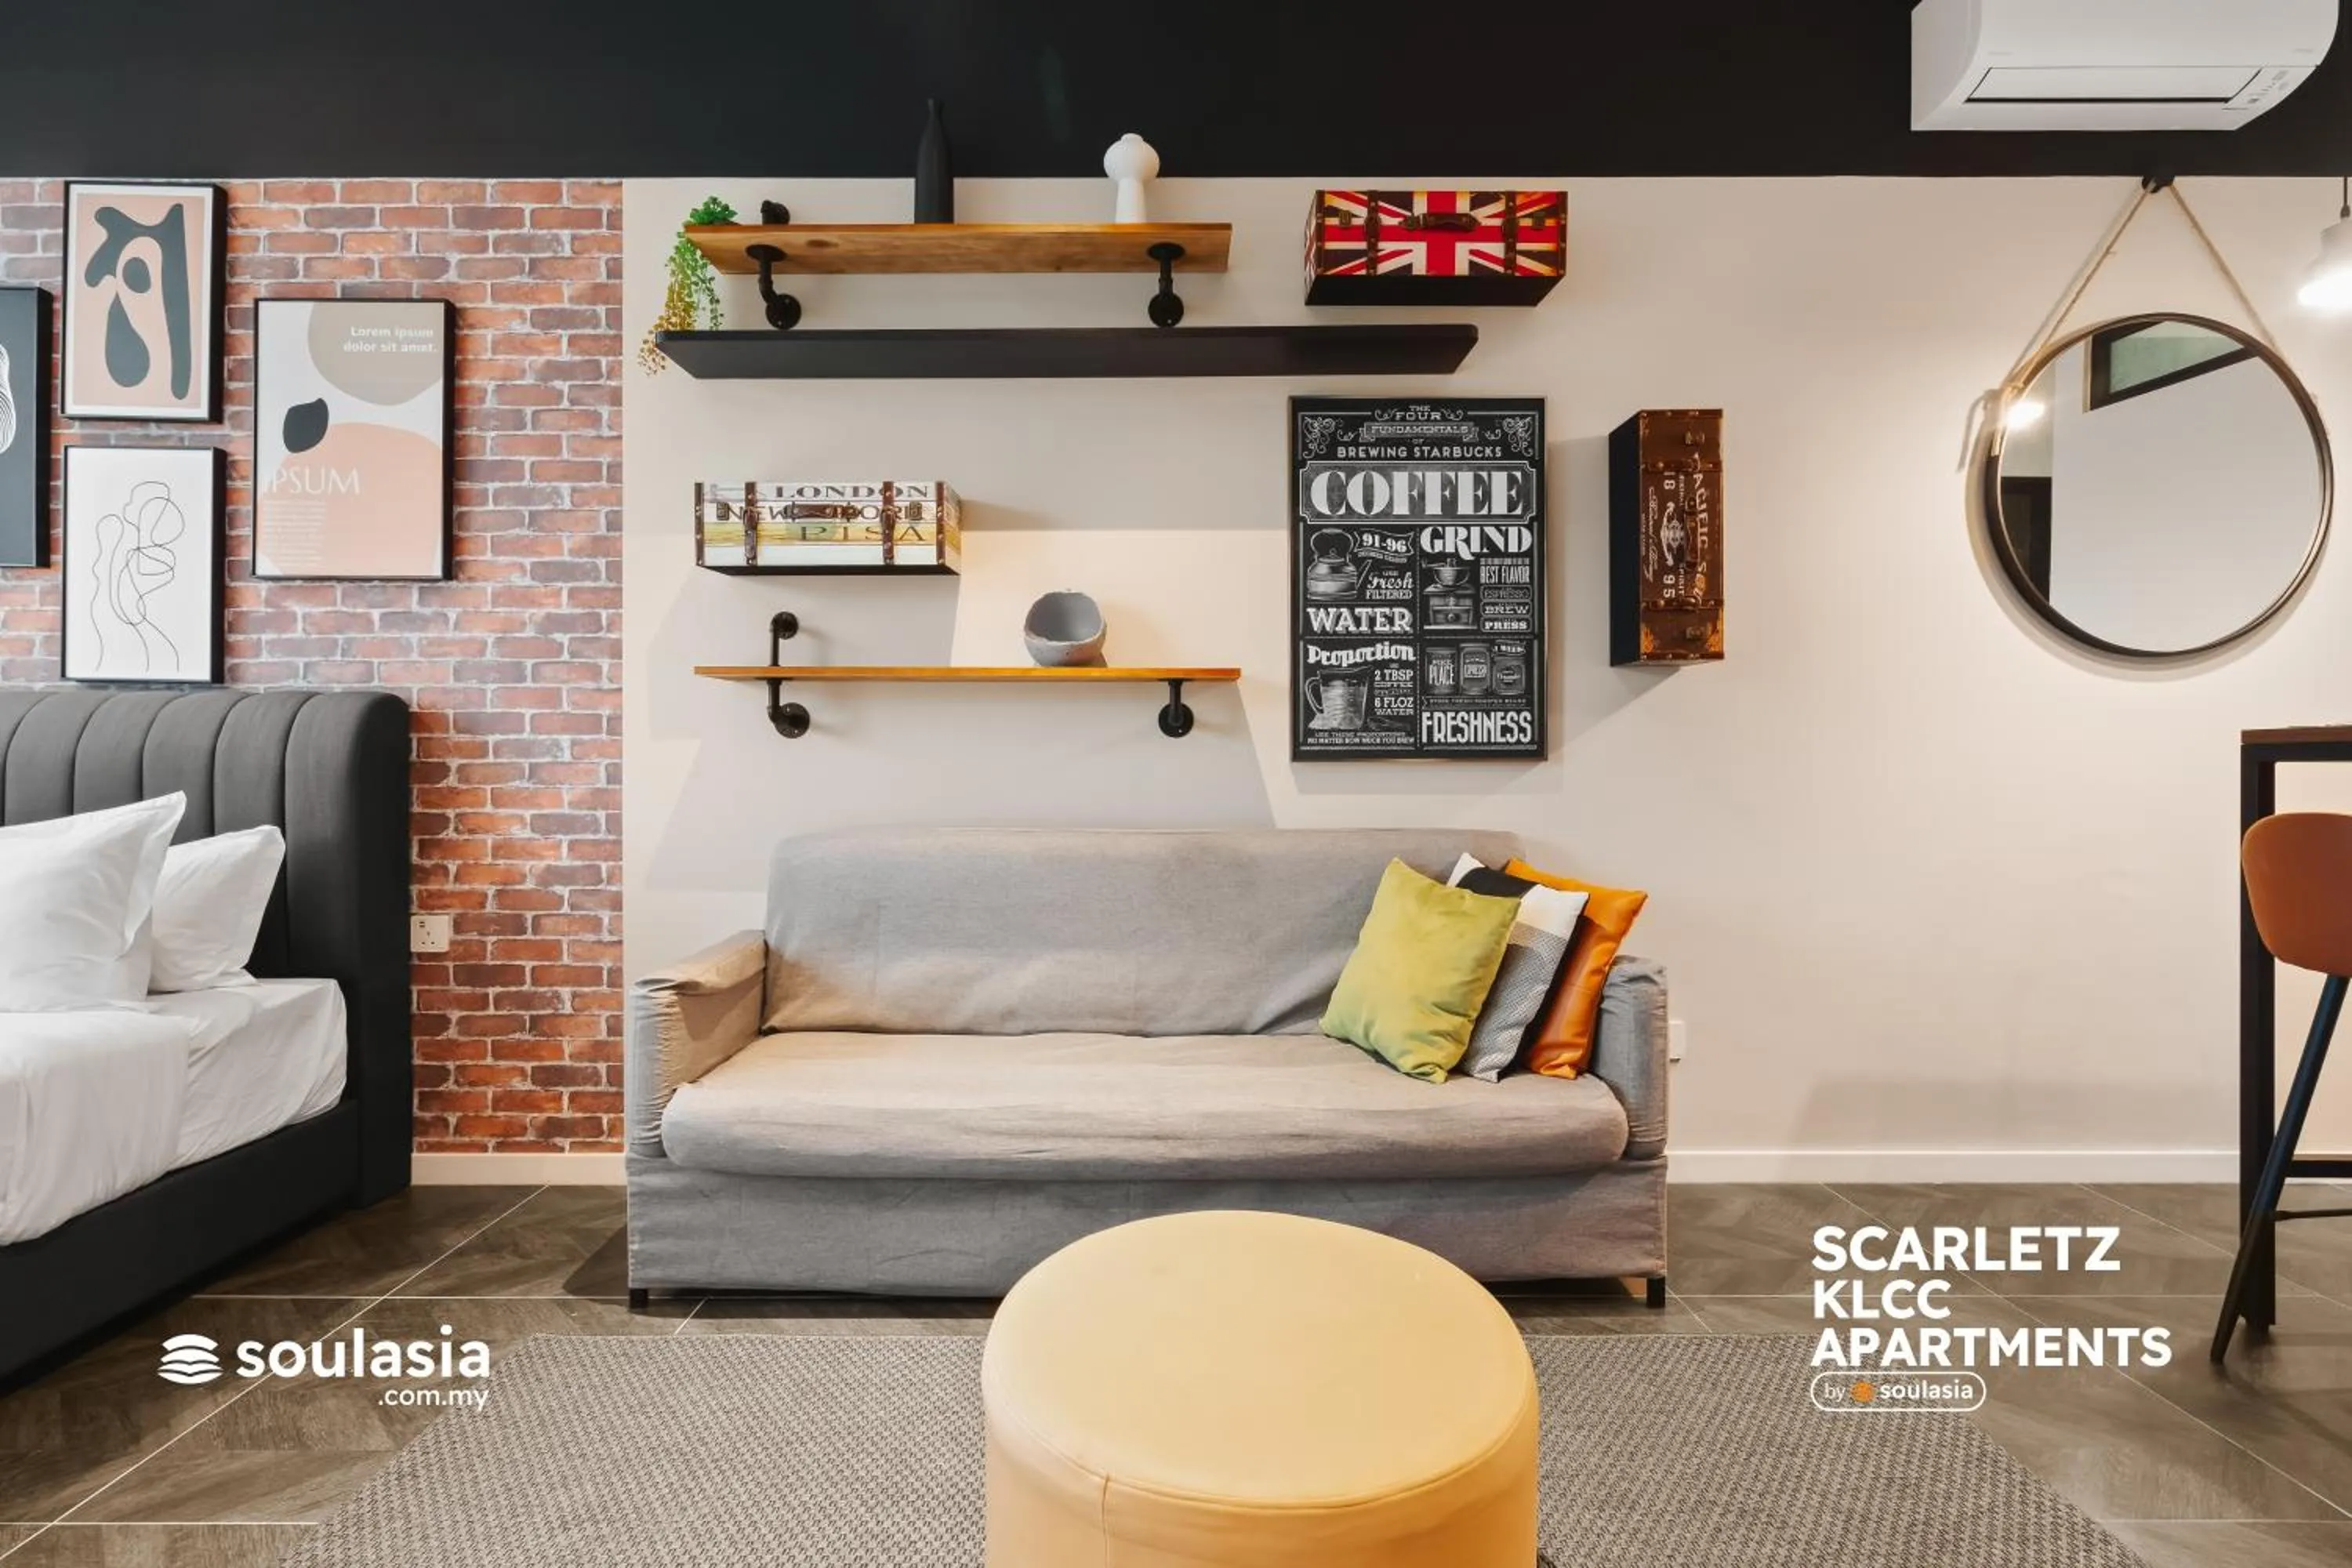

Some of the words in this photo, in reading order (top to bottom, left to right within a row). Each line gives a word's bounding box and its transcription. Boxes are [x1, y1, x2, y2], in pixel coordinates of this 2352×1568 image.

[350, 325, 391, 337] Lorem
[343, 339, 376, 352] dolor
[379, 340, 397, 352] sit
[1395, 412, 1443, 421] FOUR
[1370, 425, 1469, 434] FUNDAMENTALS
[1337, 446, 1408, 458] BREWING
[1414, 446, 1502, 458] STARBUCKS
[1310, 470, 1523, 516] COFFEE
[800, 526, 925, 541] PISA
[1362, 533, 1407, 553] 91-96
[1420, 526, 1533, 561] GRIND
[1479, 565, 1499, 583] BEST
[1662, 574, 1676, 599] 95
[1306, 607, 1414, 633] WATER
[1306, 641, 1416, 667] Proportion
[1374, 669, 1381, 681] 2
[1384, 669, 1414, 681] TBSP
[1374, 697, 1381, 708] 6
[1421, 711, 1532, 744] FRESHNESS
